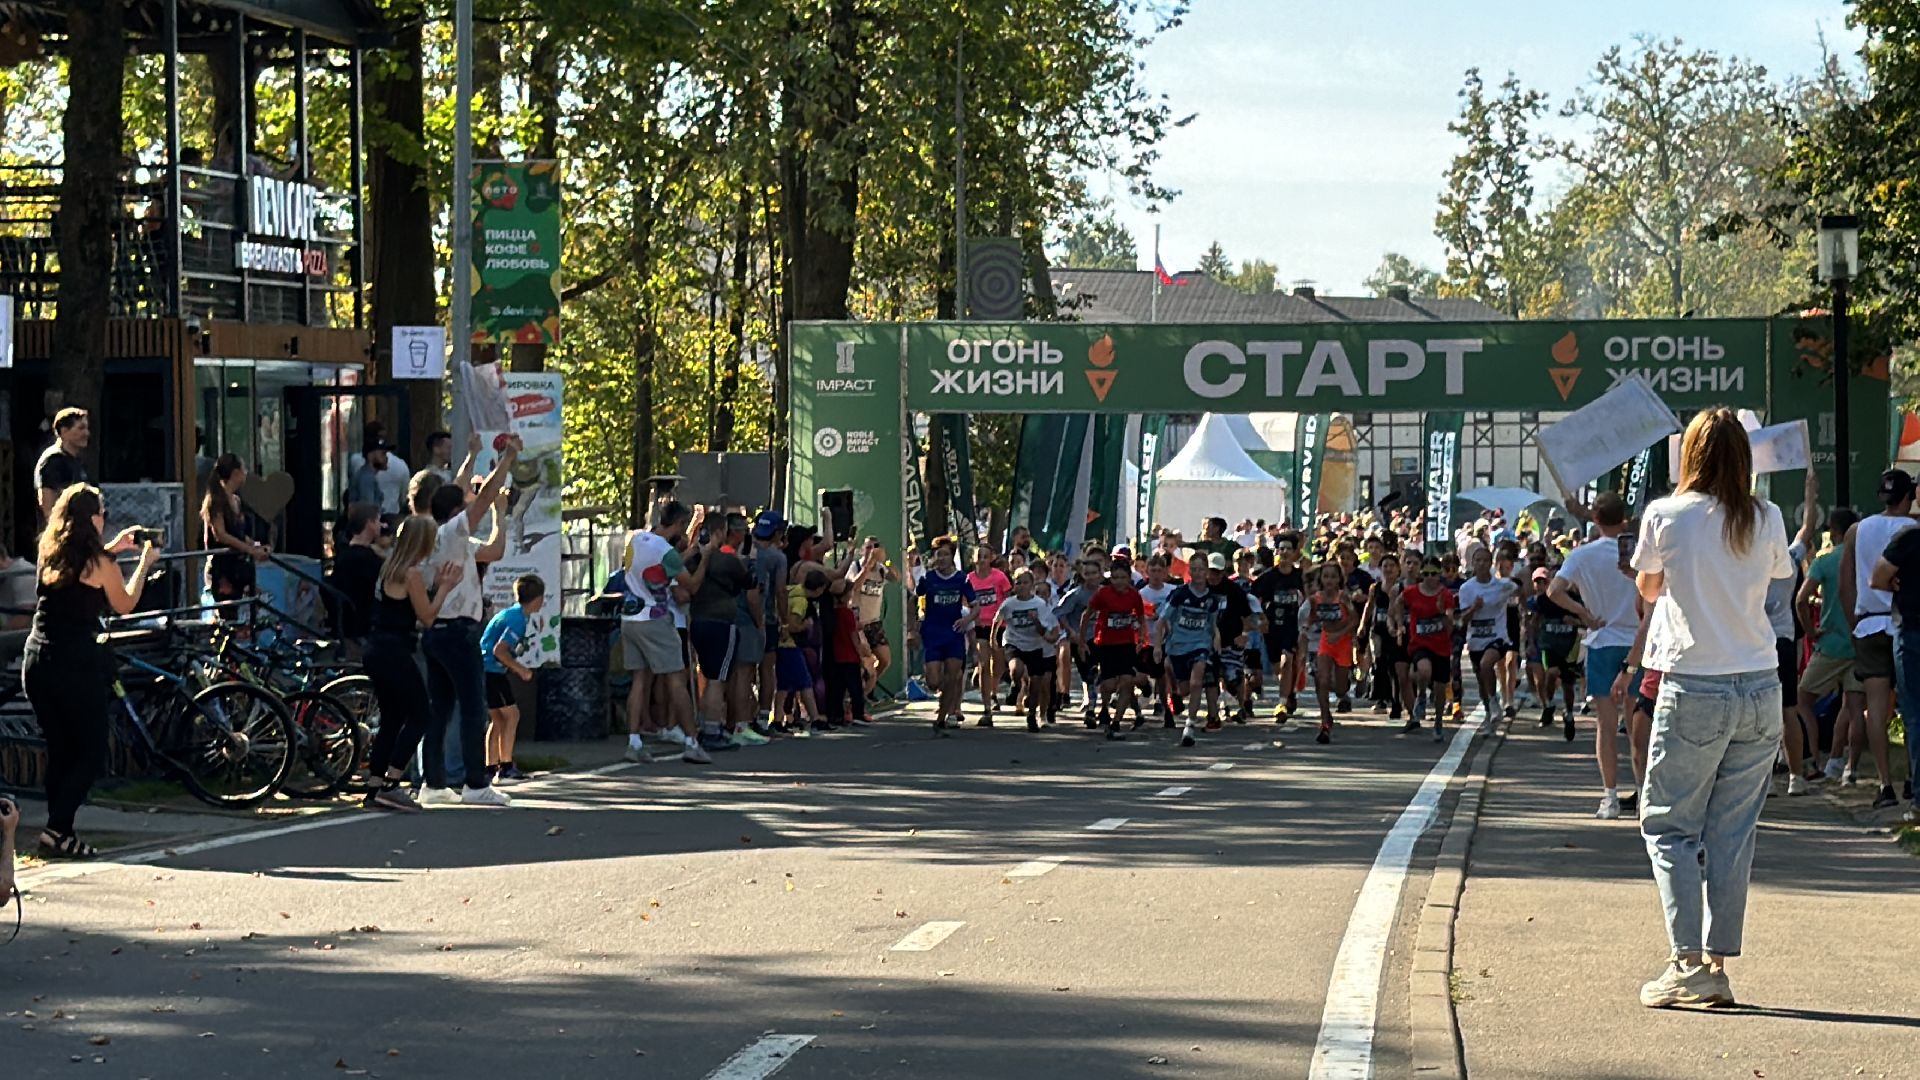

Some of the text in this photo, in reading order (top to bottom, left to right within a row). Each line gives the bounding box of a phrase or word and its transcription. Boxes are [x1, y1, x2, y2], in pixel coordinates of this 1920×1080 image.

[253, 175, 318, 240] DEVI CAFE
[485, 229, 537, 242] ПИЦЦА
[485, 243, 527, 255] КОФЕ
[303, 248, 328, 276] PIZZA
[485, 258, 550, 270] ЛЮБОВЬ
[947, 339, 1064, 365] ОГОНЬ
[1603, 336, 1726, 362] ОГОНЬ
[1183, 339, 1483, 398] СТАРТ
[816, 379, 877, 391] IMPACT
[929, 369, 1064, 395] ЖИЗНИ
[846, 430, 875, 439] NOBLE
[846, 438, 880, 447] IMPACT
[846, 445, 870, 454] CLUB
[1427, 430, 1445, 518] MAER
